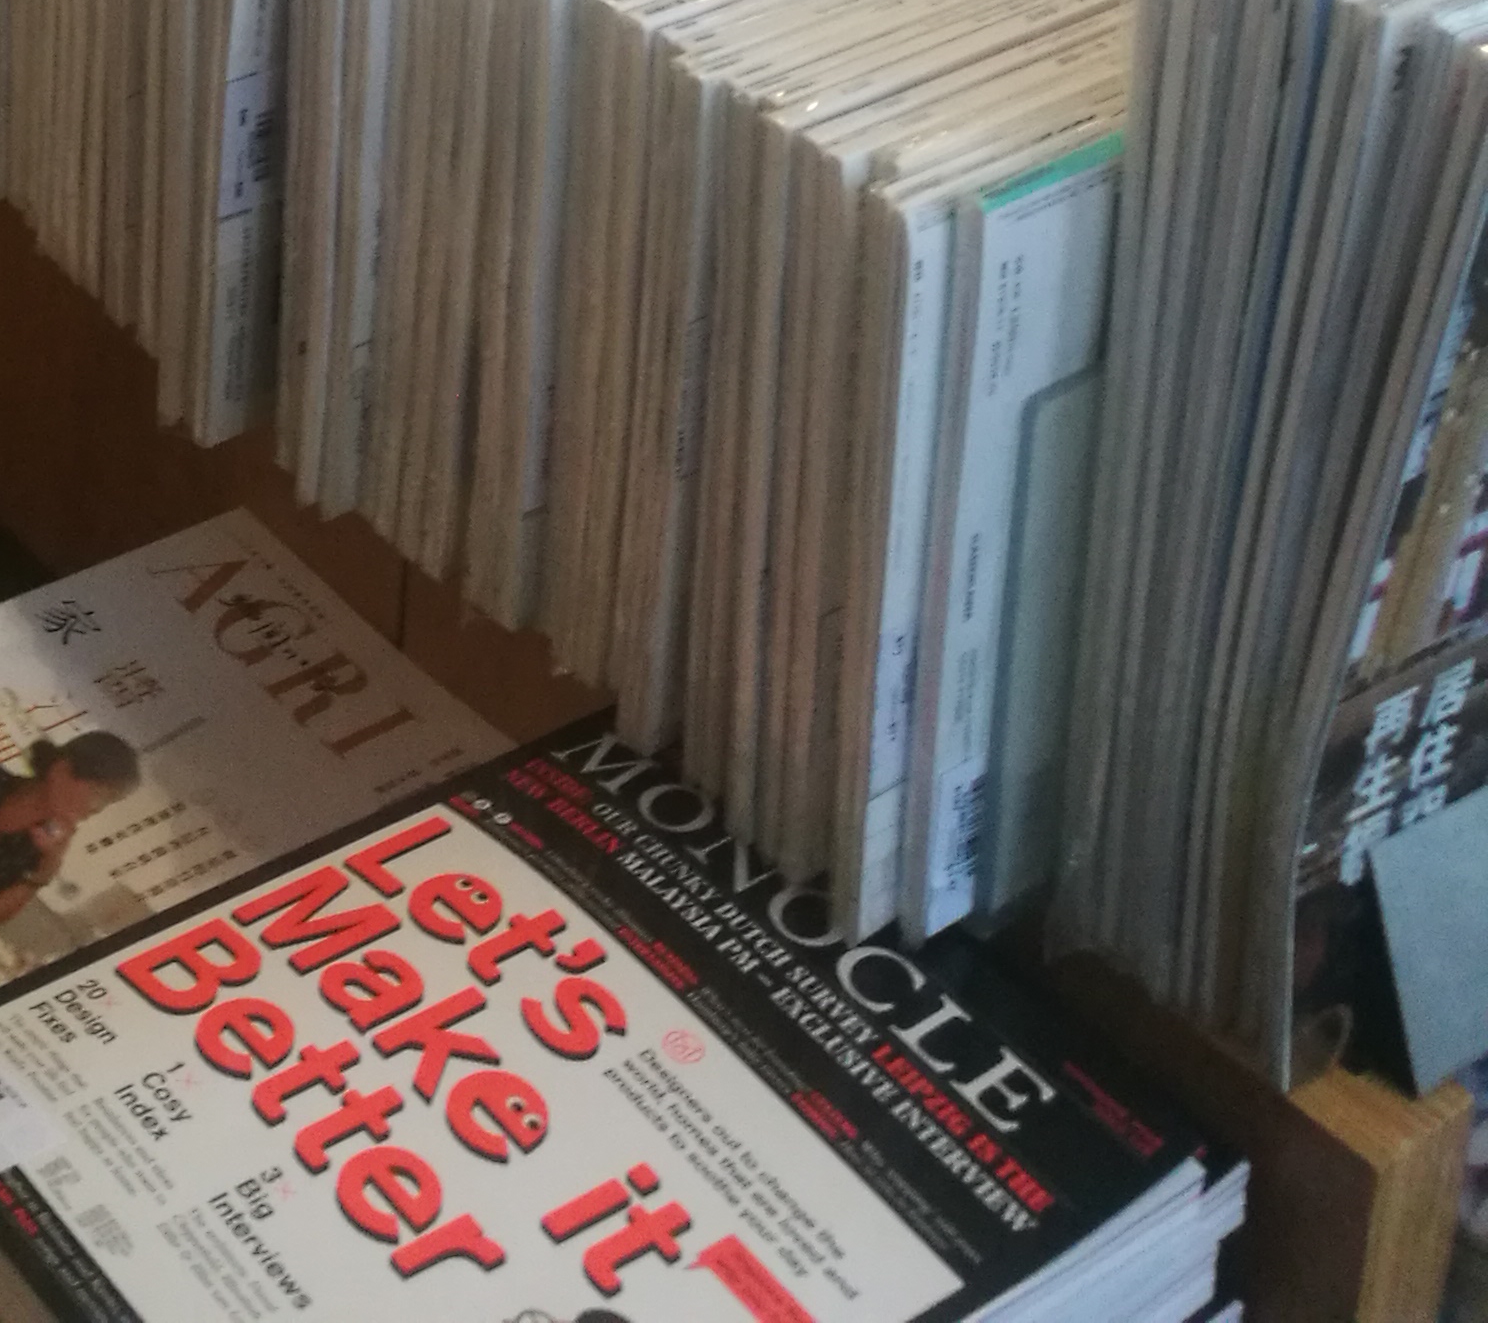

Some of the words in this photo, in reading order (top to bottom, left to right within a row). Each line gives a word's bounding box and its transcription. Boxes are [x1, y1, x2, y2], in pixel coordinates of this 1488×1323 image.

[345, 816, 628, 1061] Let's
[29, 1001, 77, 1044] Fixes
[54, 988, 118, 1046] Design
[593, 803, 639, 835] OUR
[634, 834, 723, 901] CHUNKY
[714, 902, 793, 968] DUTCH
[785, 965, 879, 1044] SURVEY
[871, 1043, 972, 1138] LEIPZIG
[995, 1157, 1055, 1214] THE
[615, 851, 723, 941] MALAYSIA
[716, 938, 760, 974] PM
[770, 986, 899, 1102] EXCLUSIVE
[890, 1099, 1039, 1232] INTERVIEW
[114, 1083, 169, 1142] Index
[115, 917, 508, 1281] Better
[141, 1071, 192, 1124] Cosy
[232, 865, 549, 1166] Make
[540, 1162, 693, 1298] it
[208, 1191, 312, 1312] Interviews
[235, 1177, 275, 1221] Big
